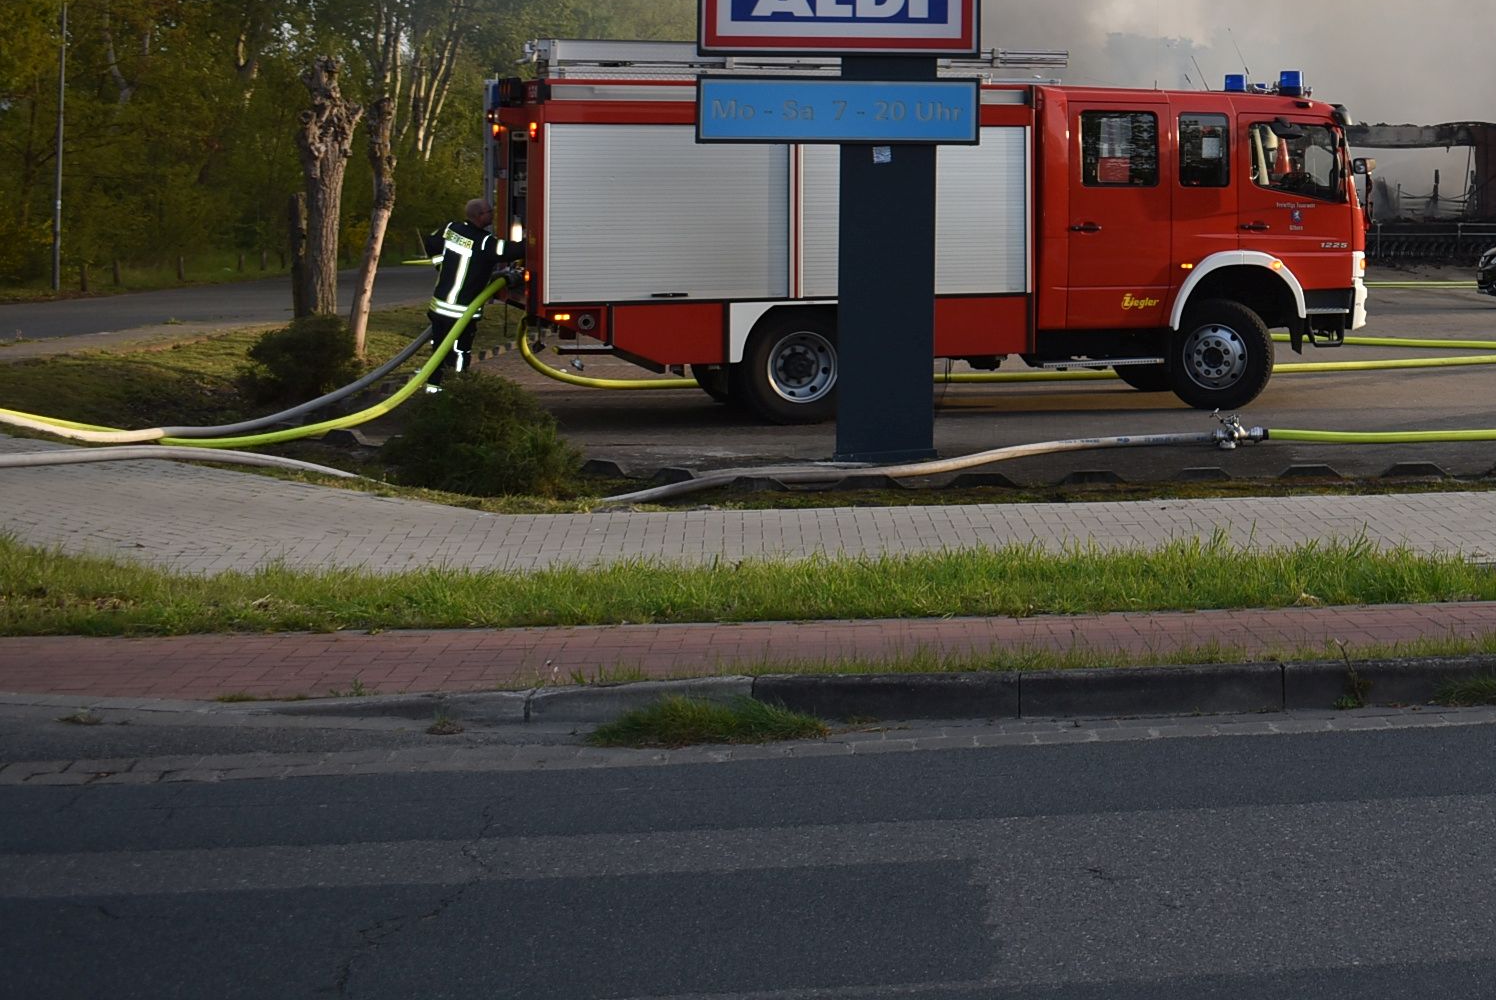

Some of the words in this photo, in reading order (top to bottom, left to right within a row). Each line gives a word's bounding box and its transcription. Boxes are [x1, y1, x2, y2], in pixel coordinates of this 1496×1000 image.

[711, 99, 756, 121] Mo
[782, 99, 815, 121] Sa
[831, 100, 848, 121] 7
[874, 100, 906, 121] 20
[915, 100, 964, 122] Uhr
[1121, 293, 1160, 310] Ziegler
